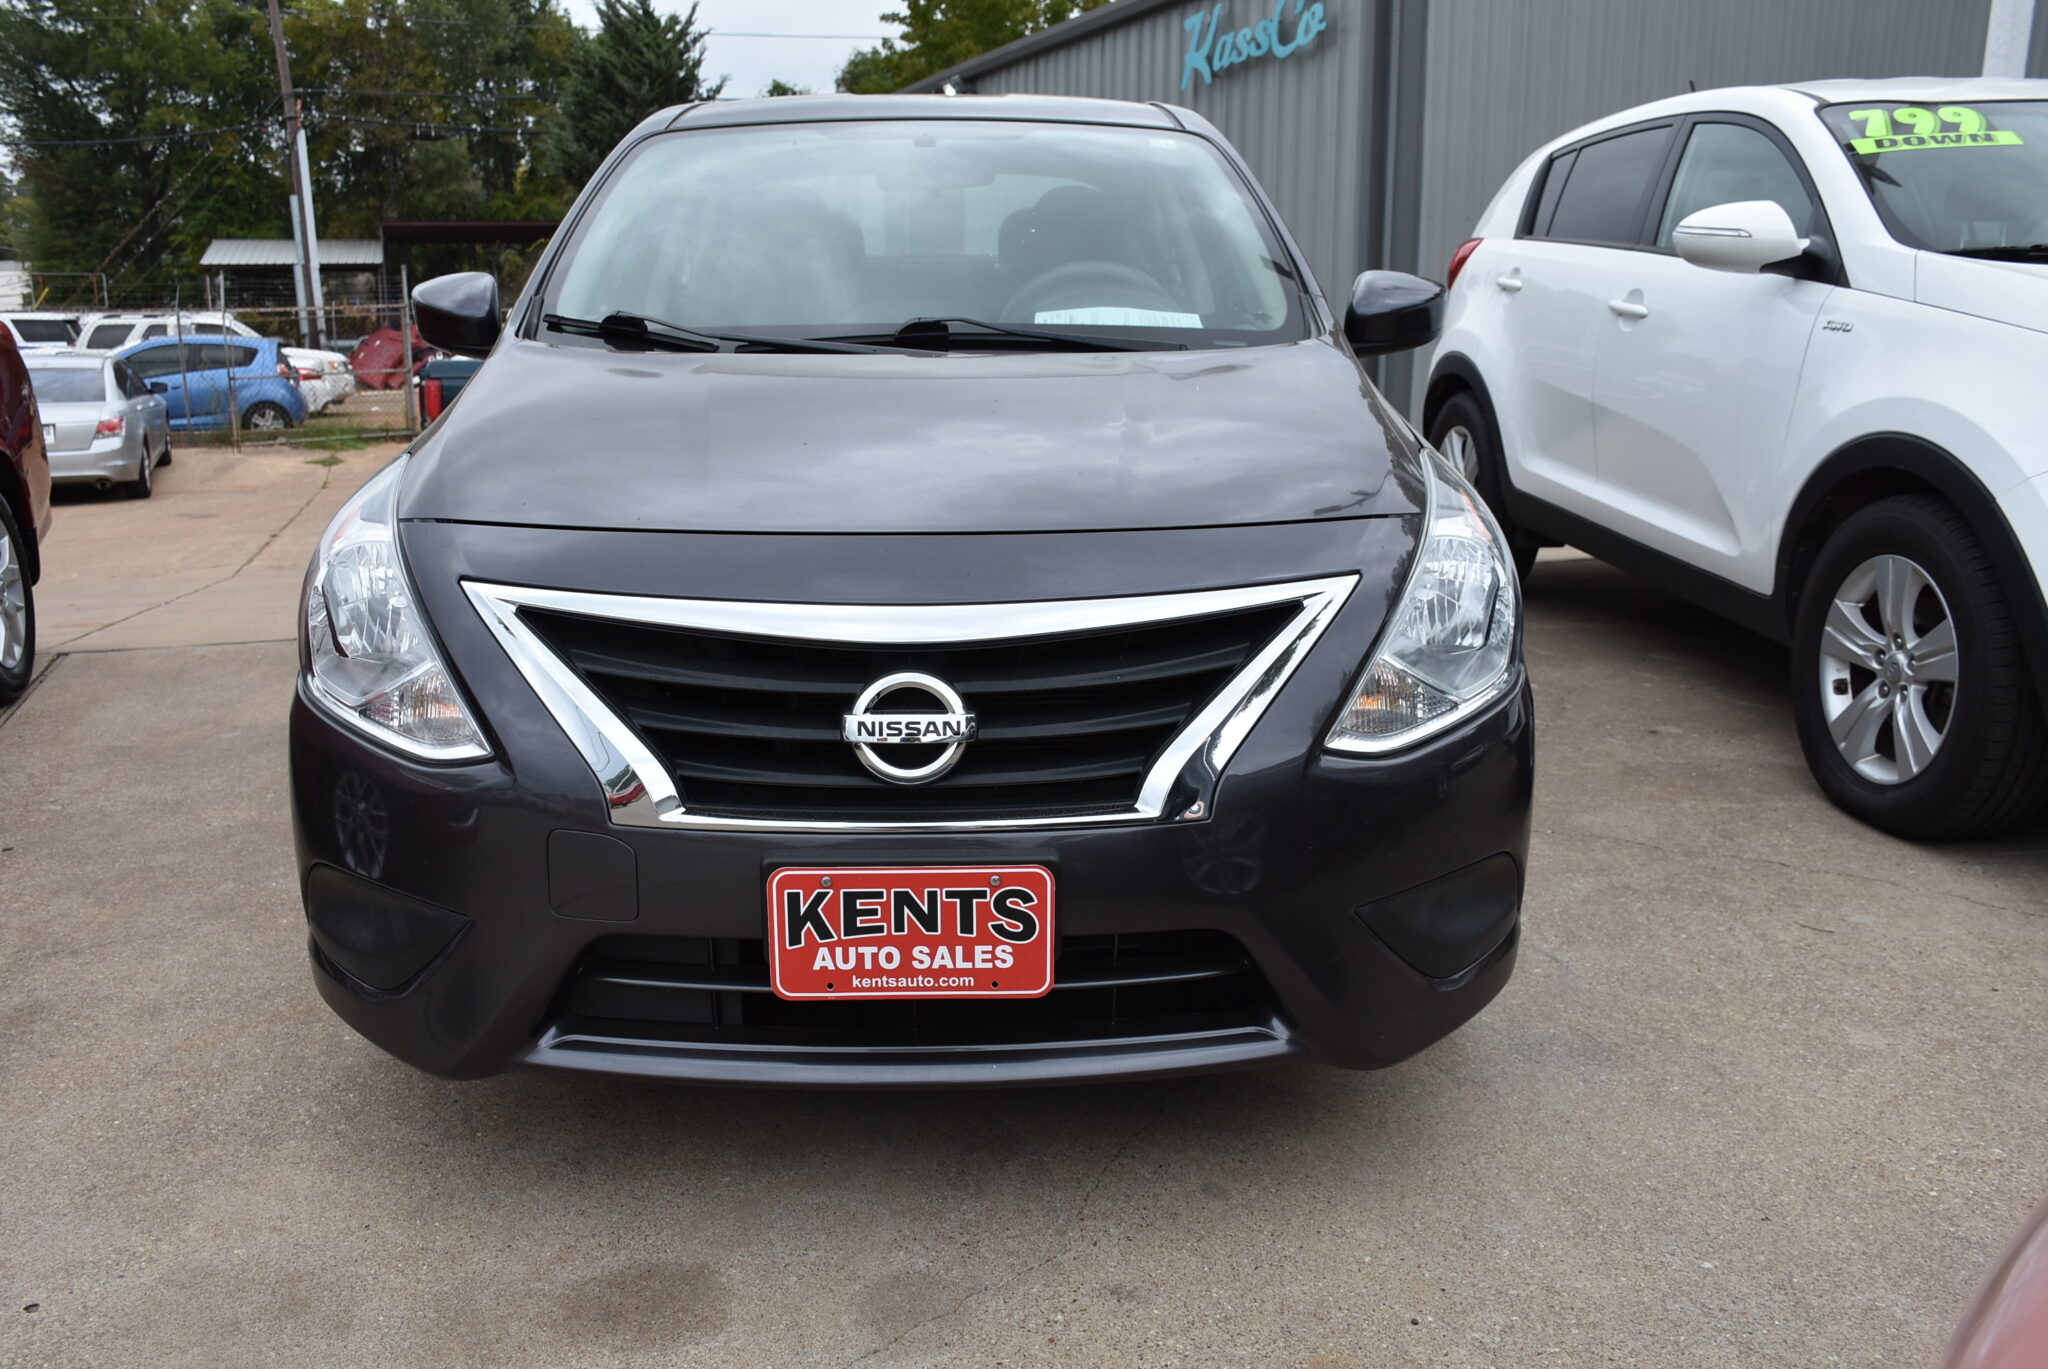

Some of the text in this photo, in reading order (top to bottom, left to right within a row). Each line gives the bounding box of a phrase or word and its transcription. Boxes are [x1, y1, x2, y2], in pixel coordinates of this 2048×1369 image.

[1180, 0, 1327, 91] KassCo
[1849, 106, 1987, 137] 799
[1874, 133, 1996, 149] DOWN
[857, 720, 961, 737] NISSAN
[784, 886, 1039, 949] KENTS
[813, 945, 1014, 970] AUTO SALES
[852, 974, 974, 988] kentsauto.com
